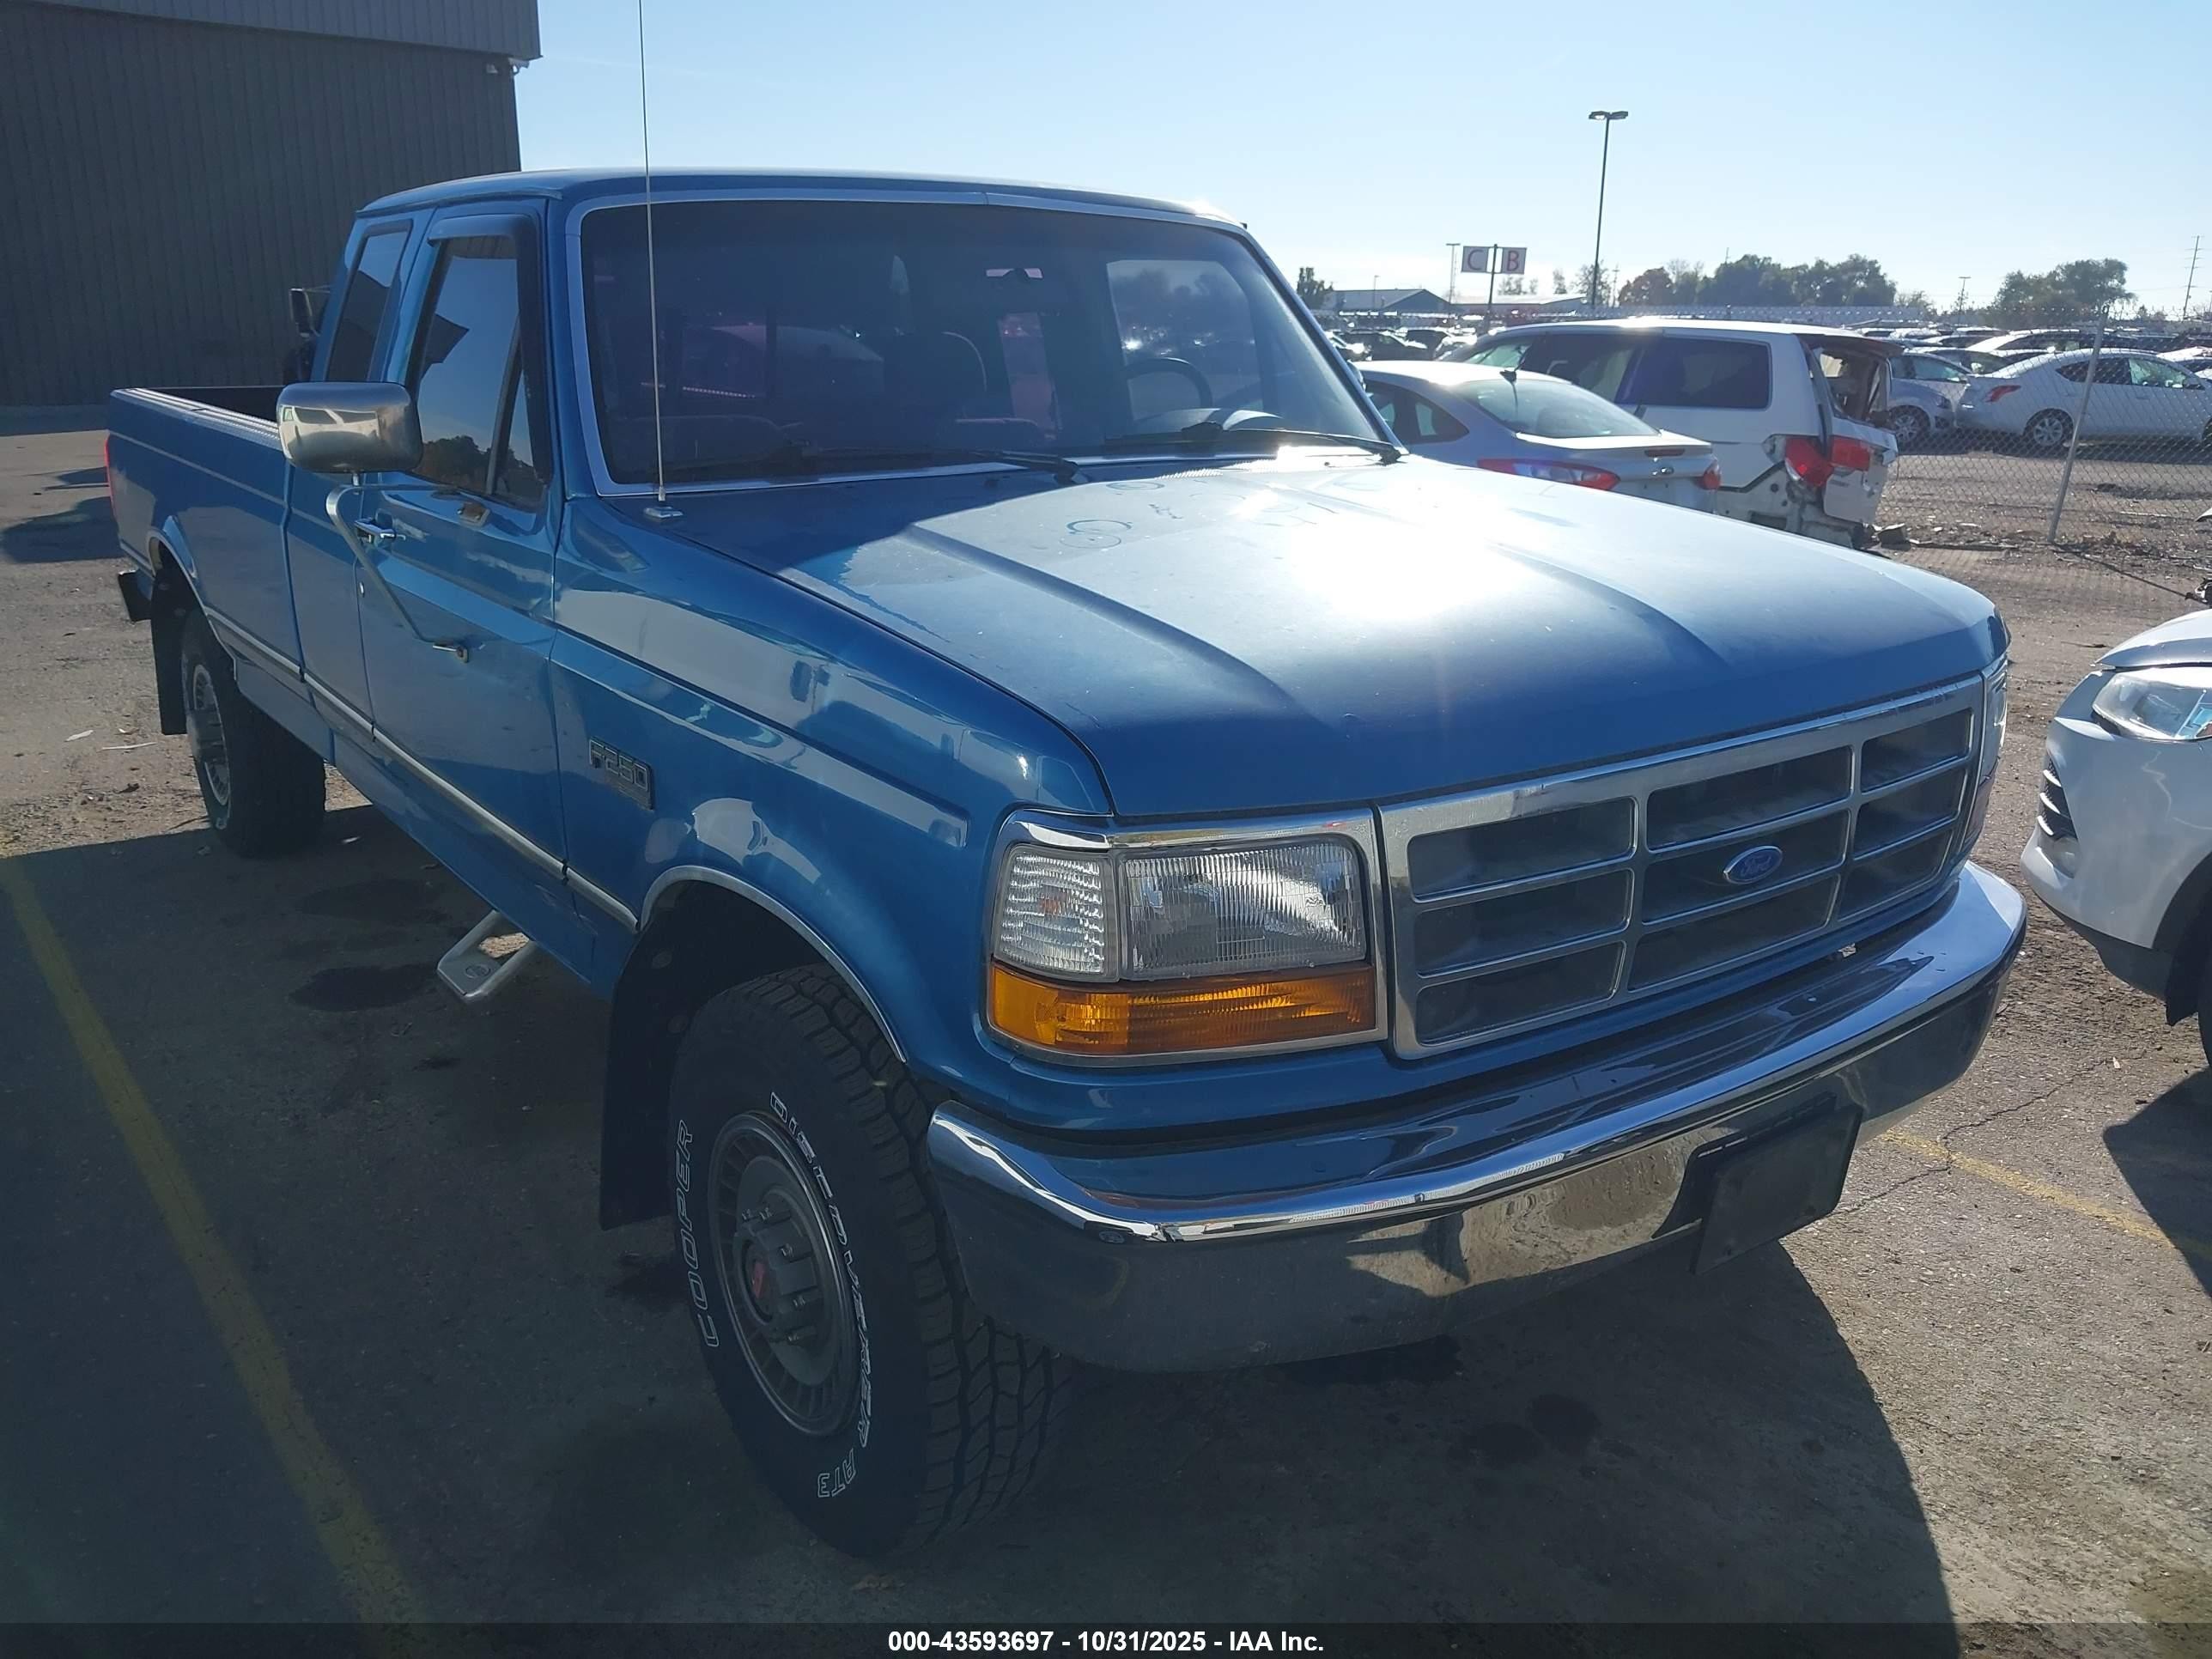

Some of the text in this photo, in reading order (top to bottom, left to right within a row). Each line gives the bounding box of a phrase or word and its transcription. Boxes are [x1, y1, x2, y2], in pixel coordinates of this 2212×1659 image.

[1468, 249, 1486, 270] C
[1507, 250, 1519, 272] B
[676, 1119, 720, 1347] COOPER
[769, 1091, 872, 1498] DISCOVERER AT3
